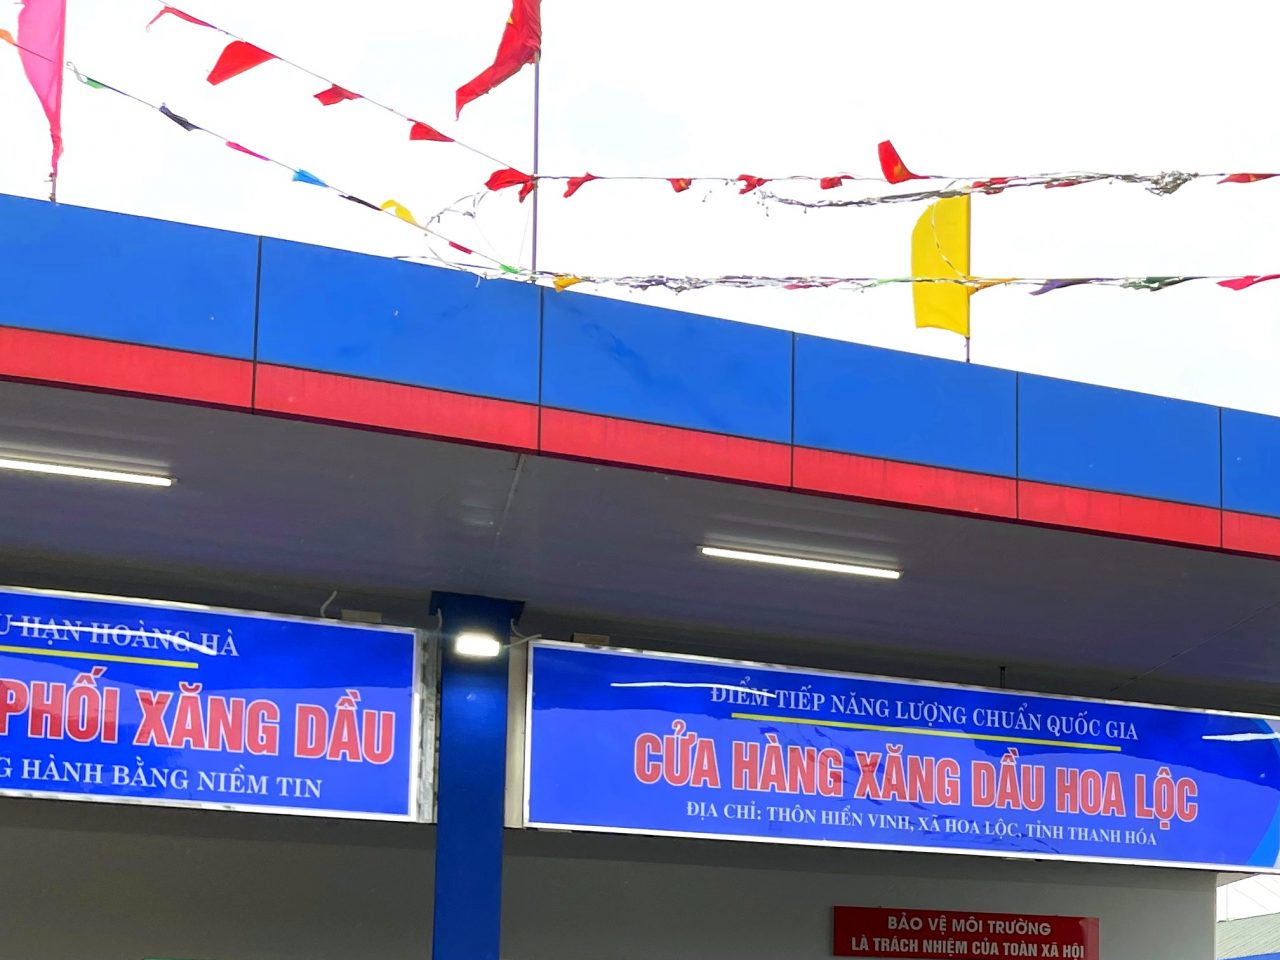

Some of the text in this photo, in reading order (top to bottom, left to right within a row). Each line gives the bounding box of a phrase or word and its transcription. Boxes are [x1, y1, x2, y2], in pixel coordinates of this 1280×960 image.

[20, 615, 82, 645] HẠN
[90, 619, 191, 652] HOÀNG
[200, 629, 240, 656] HÀ
[0, 666, 395, 765] PHỐI XĂNG DẦU
[710, 676, 1138, 740] ĐIỂM TIẾP NĂNG LƯỢNG CHUẨN QUỐC GIA
[21, 754, 103, 784] HÀNH
[111, 756, 189, 790] BẰNG
[197, 765, 269, 796] NIỀM
[277, 777, 322, 798] TIN
[634, 719, 1198, 830] CỬA HÀNG XĂNG DẦU HOA LỘC
[686, 801, 718, 821] ĐỊA
[723, 800, 761, 820] CHỈ:
[767, 806, 816, 824] THÔN
[868, 814, 914, 832] VINH,
[918, 815, 941, 832] XÃ
[945, 818, 980, 834] HOA
[1026, 820, 1064, 840] TỈNH
[1068, 827, 1121, 843] THANH
[1125, 830, 1157, 846] HÓA
[888, 912, 1051, 936] BẢO VỆ MÔI TRƯỜNG
[851, 934, 1084, 960] LÀ TRÁCH NHIỆM CỦA TOÀN XÃ HỘI
